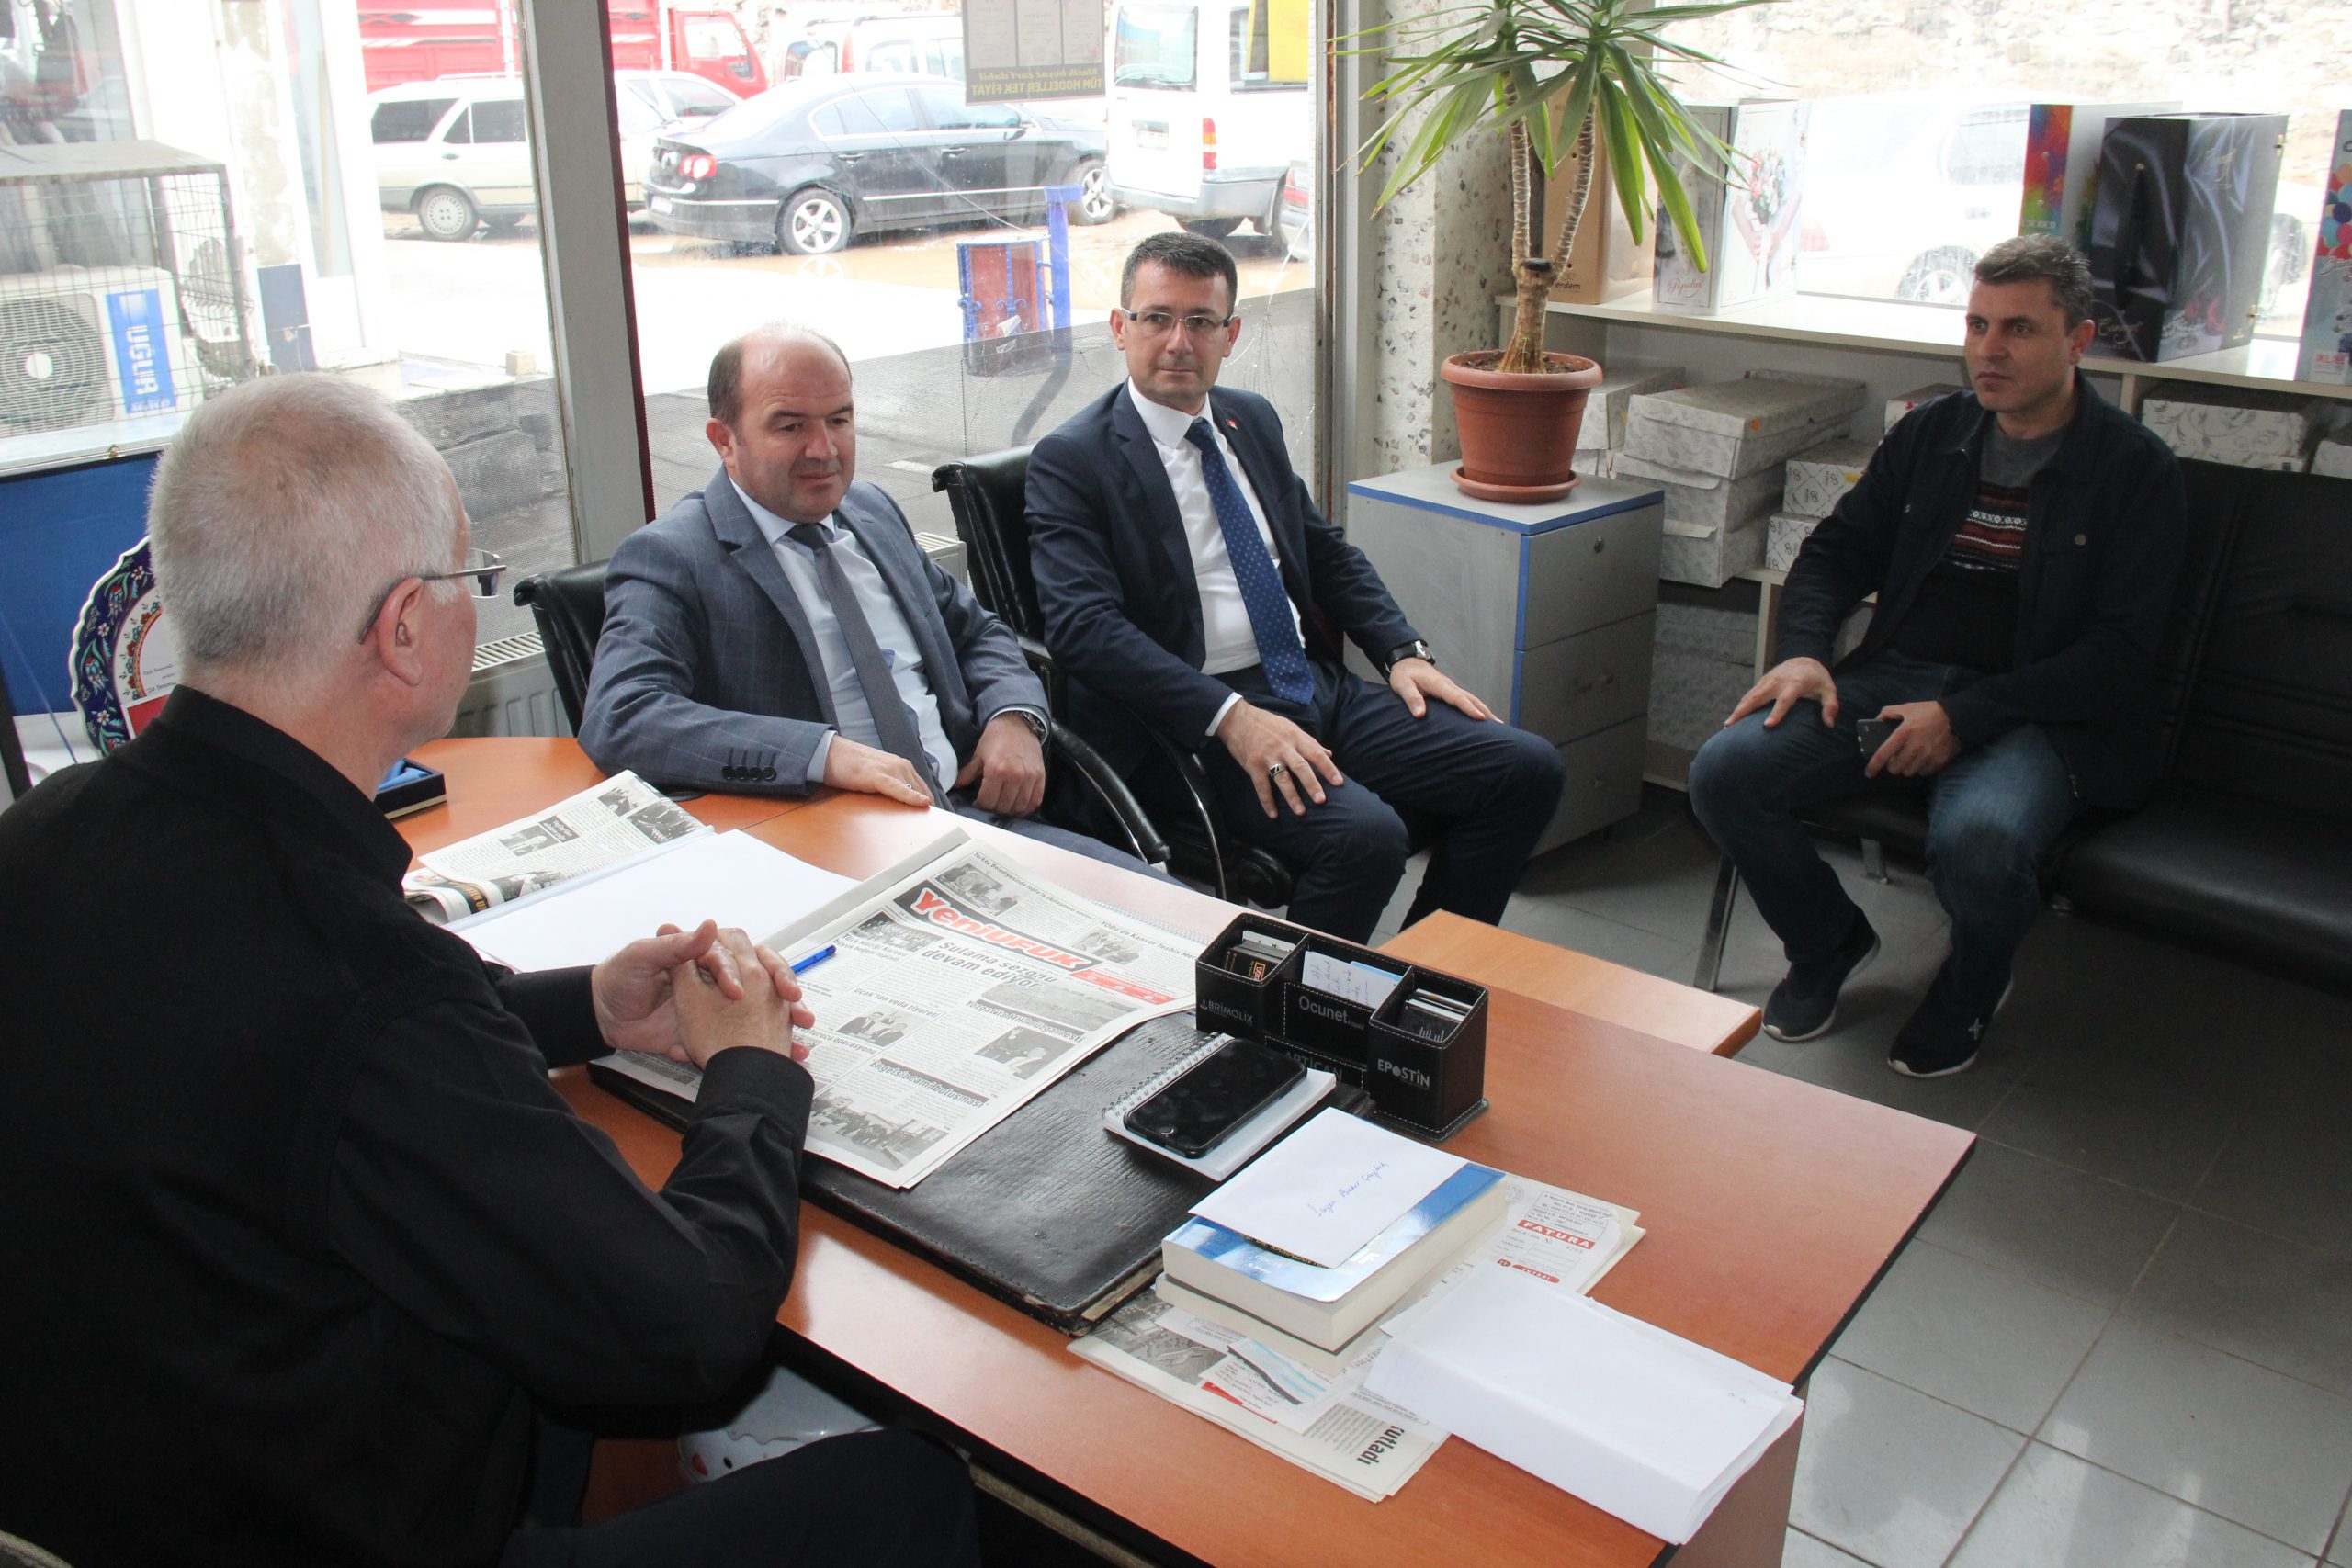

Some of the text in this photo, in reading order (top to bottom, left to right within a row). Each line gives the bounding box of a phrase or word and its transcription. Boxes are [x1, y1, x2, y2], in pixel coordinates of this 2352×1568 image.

[1555, 279, 1581, 291] erdem
[922, 949, 1044, 989] devam ediyor
[938, 942, 1057, 984] Sulama sezonu
[888, 998, 909, 1009] veda
[1298, 995, 1349, 1025] Ocunet
[1522, 1221, 1591, 1247] FATURA
